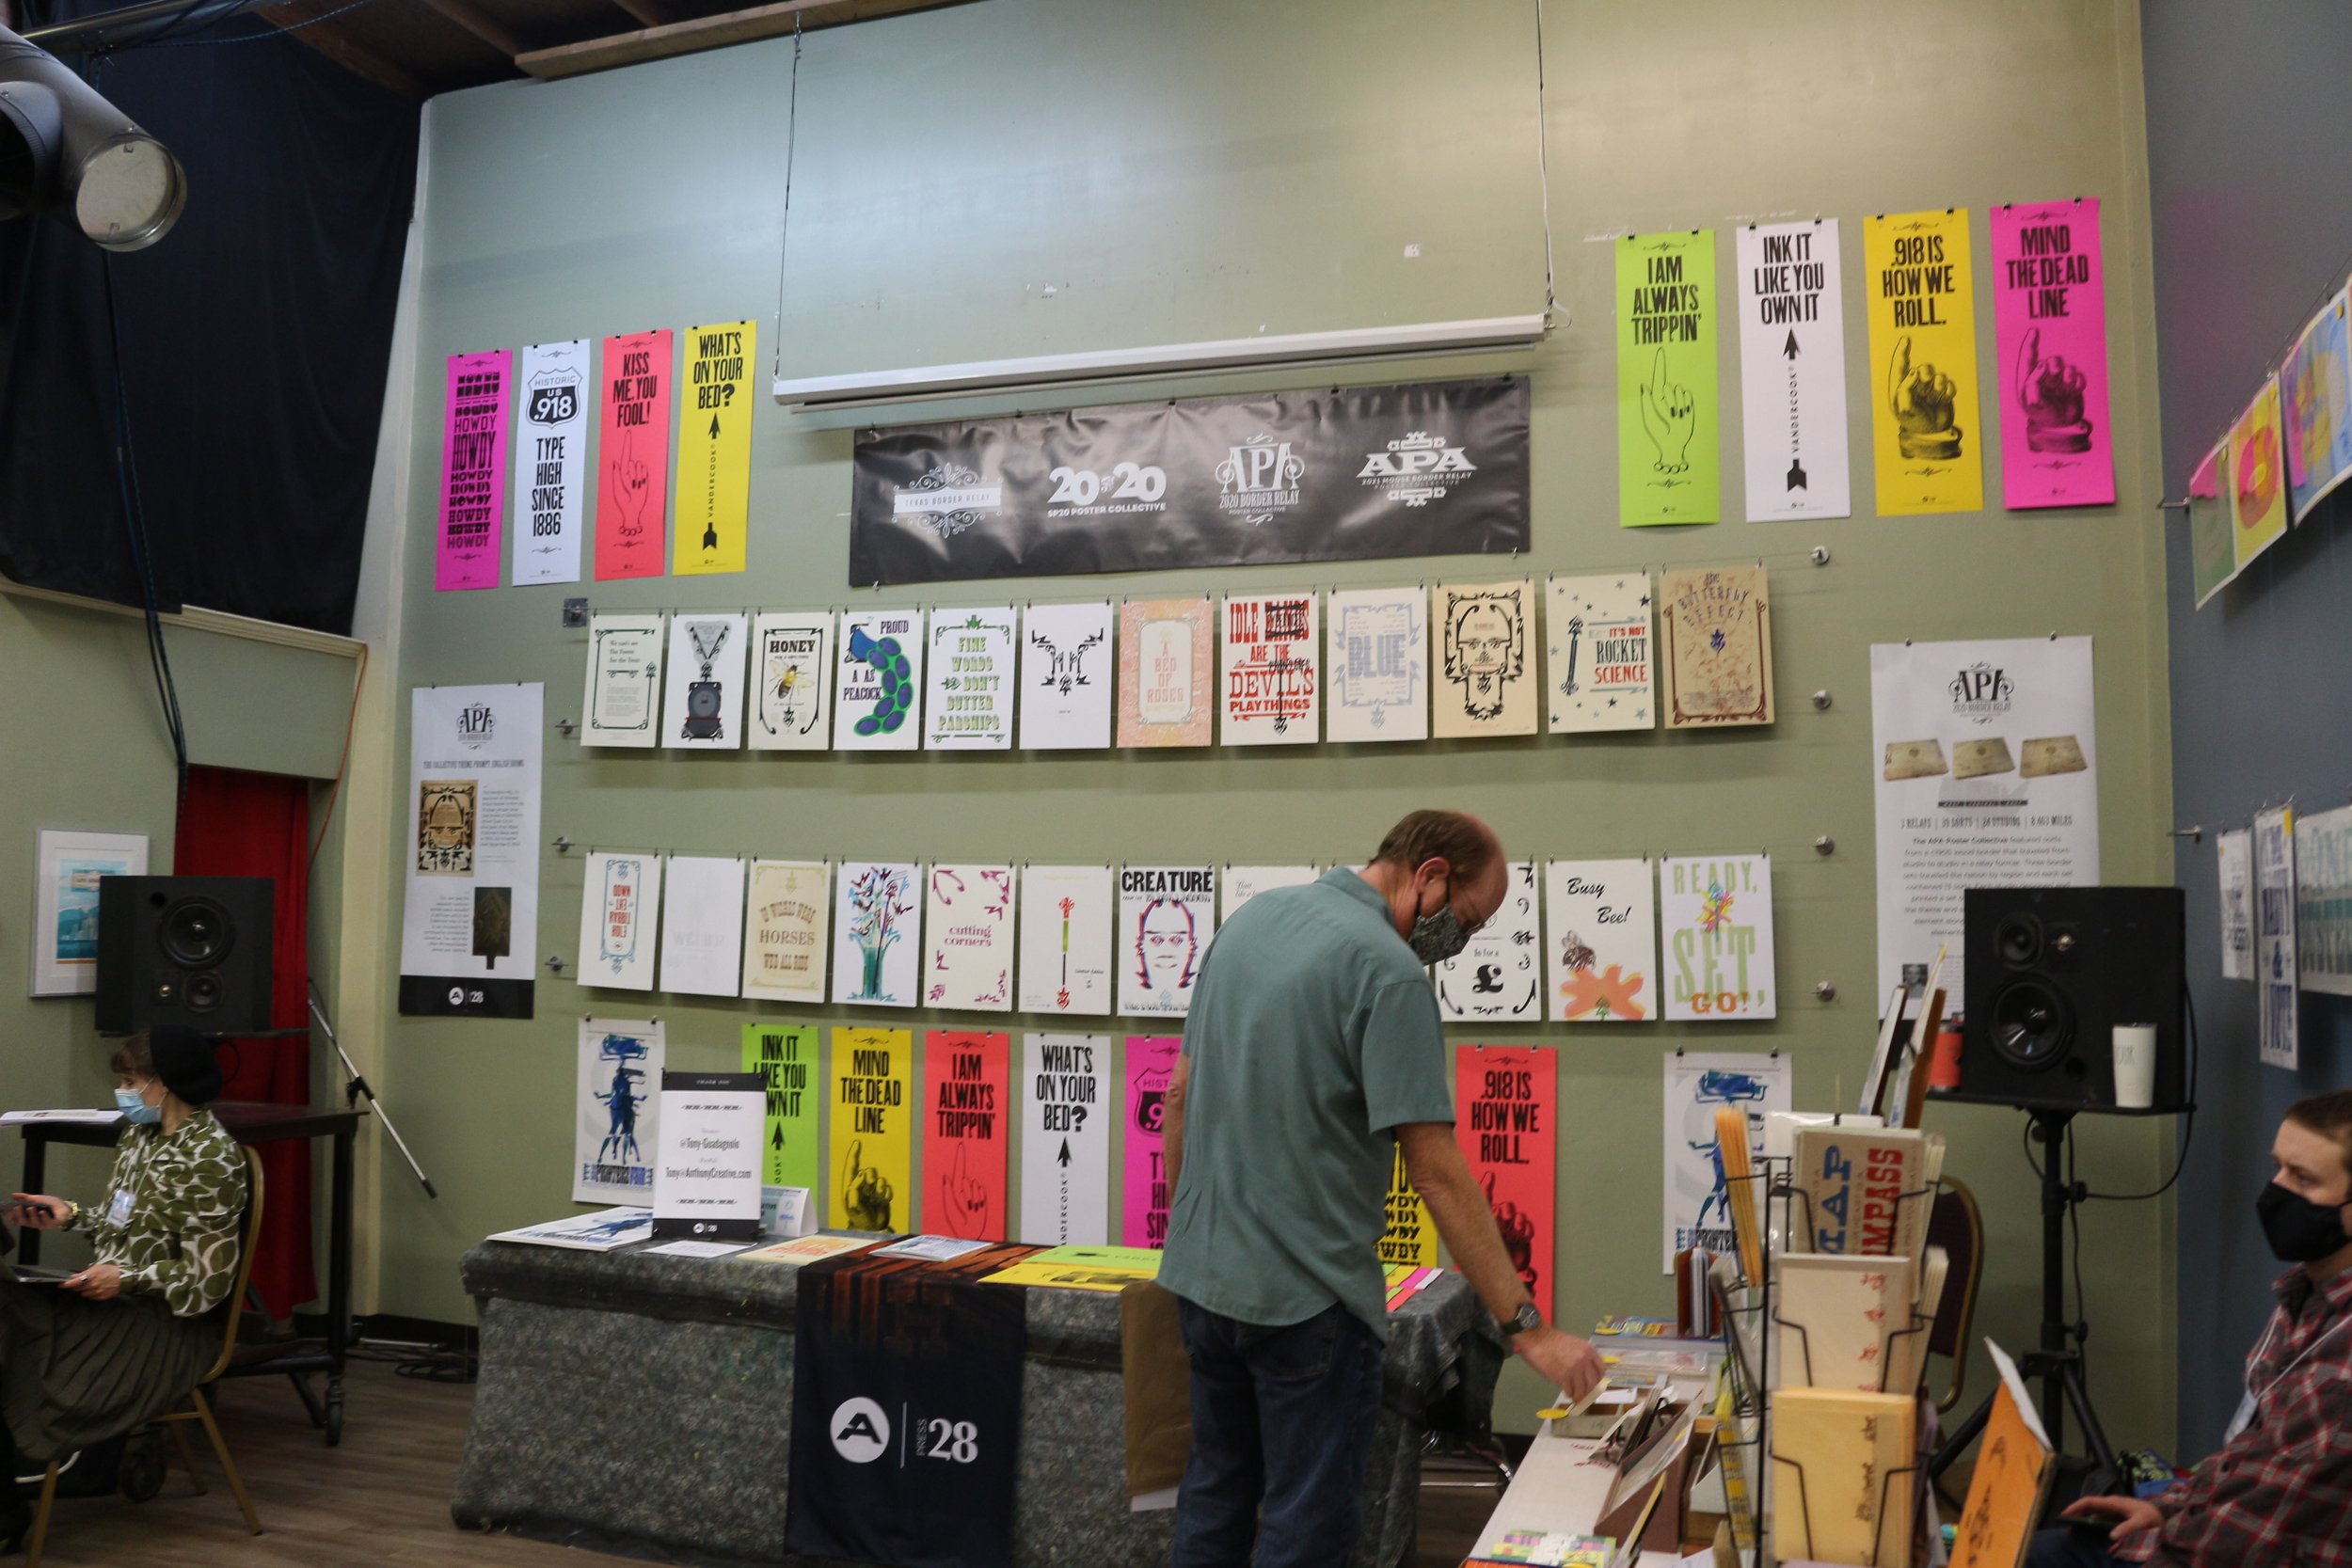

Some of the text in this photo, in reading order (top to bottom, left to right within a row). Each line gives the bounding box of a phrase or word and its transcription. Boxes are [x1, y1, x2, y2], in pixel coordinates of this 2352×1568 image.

[1764, 233, 1812, 263] INK IT
[1892, 236, 1943, 267] .918 IS
[2021, 225, 2070, 257] MIND
[1647, 256, 1682, 284] I AM
[1755, 262, 1823, 294] LIKE YOU
[1883, 265, 1955, 298] HOW WE
[2006, 253, 2089, 290] THE DEAD
[1633, 285, 1698, 314] ALWAYS
[1761, 293, 1819, 325] OWN IT
[1894, 297, 1947, 327] ROLL.
[2028, 288, 2069, 319] LINE
[1631, 314, 1701, 345] TRIPPIN'
[699, 332, 741, 357] WHAT'S
[624, 352, 649, 375] KISS
[694, 357, 742, 384] ON YOUR
[534, 374, 576, 387] HISTORIC
[547, 388, 562, 397] US
[534, 396, 572, 420] .918
[698, 384, 735, 409] BED?
[454, 416, 496, 433] HOWDY
[617, 402, 650, 428] FOOL!
[453, 432, 496, 470] HOWDY
[537, 436, 565, 461] TYPE
[536, 462, 562, 486] HIGH
[1217, 443, 1303, 493] APA
[1356, 447, 1478, 478] APA
[451, 470, 492, 482] HOWDY
[451, 483, 490, 495] HOWDY
[532, 487, 564, 512] SINCE
[1072, 506, 1107, 515] POSTER
[1109, 503, 1166, 513] COLLECTIVE
[449, 507, 491, 522] HOWDY
[532, 513, 561, 536] 1886
[447, 534, 489, 548] HOWDY
[881, 621, 909, 634] PROUD
[1231, 602, 1258, 643] IDLE
[1629, 626, 1646, 636] NOT
[769, 641, 815, 653] HONEY
[1251, 644, 1290, 662] ARE THE
[1349, 634, 1406, 677] BLUE
[1597, 639, 1646, 664] ROCKET
[1155, 657, 1176, 672] BED
[1595, 664, 1647, 685] SCIENCE
[843, 687, 882, 700] PEACOCK
[1147, 687, 1184, 703] ROSES
[1230, 699, 1311, 712] PLAYTHINGS
[1122, 871, 1213, 892] CREATURE
[1567, 879, 1605, 899] Busy
[1674, 863, 1756, 895] READY,
[1597, 907, 1632, 925] Bee!
[760, 930, 815, 945] HORSES
[945, 937, 992, 946] corners
[949, 926, 992, 937] cutting
[1672, 926, 1764, 1007] SET,
[1692, 992, 1748, 1013] GO!
[762, 1035, 799, 1061] INK IT
[1042, 1045, 1092, 1073] WHAT'S
[784, 1063, 806, 1089] YOU
[852, 1050, 889, 1077] MIND
[952, 1054, 981, 1081] I AM
[841, 1077, 901, 1106] THE DEAD
[939, 1083, 993, 1111] ALWAYS
[1037, 1074, 1096, 1103] ON YOUR
[1481, 1071, 1532, 1101] .918 IS
[766, 1090, 802, 1117] WN IT
[1145, 1103, 1164, 1129] .9
[1471, 1101, 1540, 1132] HOW WE
[854, 1106, 885, 1134] LINE
[937, 1111, 995, 1139] TRIPPIN'
[1044, 1105, 1087, 1132] BED?
[1481, 1135, 1529, 1164] ROLL.
[1152, 1183, 1168, 1210] HI
[1386, 1195, 1422, 1207] WDY
[1861, 1148, 1902, 1256] MPASS
[1147, 1212, 1168, 1240] SIN
[1385, 1211, 1421, 1223] WDY
[1386, 1227, 1421, 1240] WDY
[1376, 1243, 1422, 1259] WDY
[928, 1418, 978, 1464] 28
